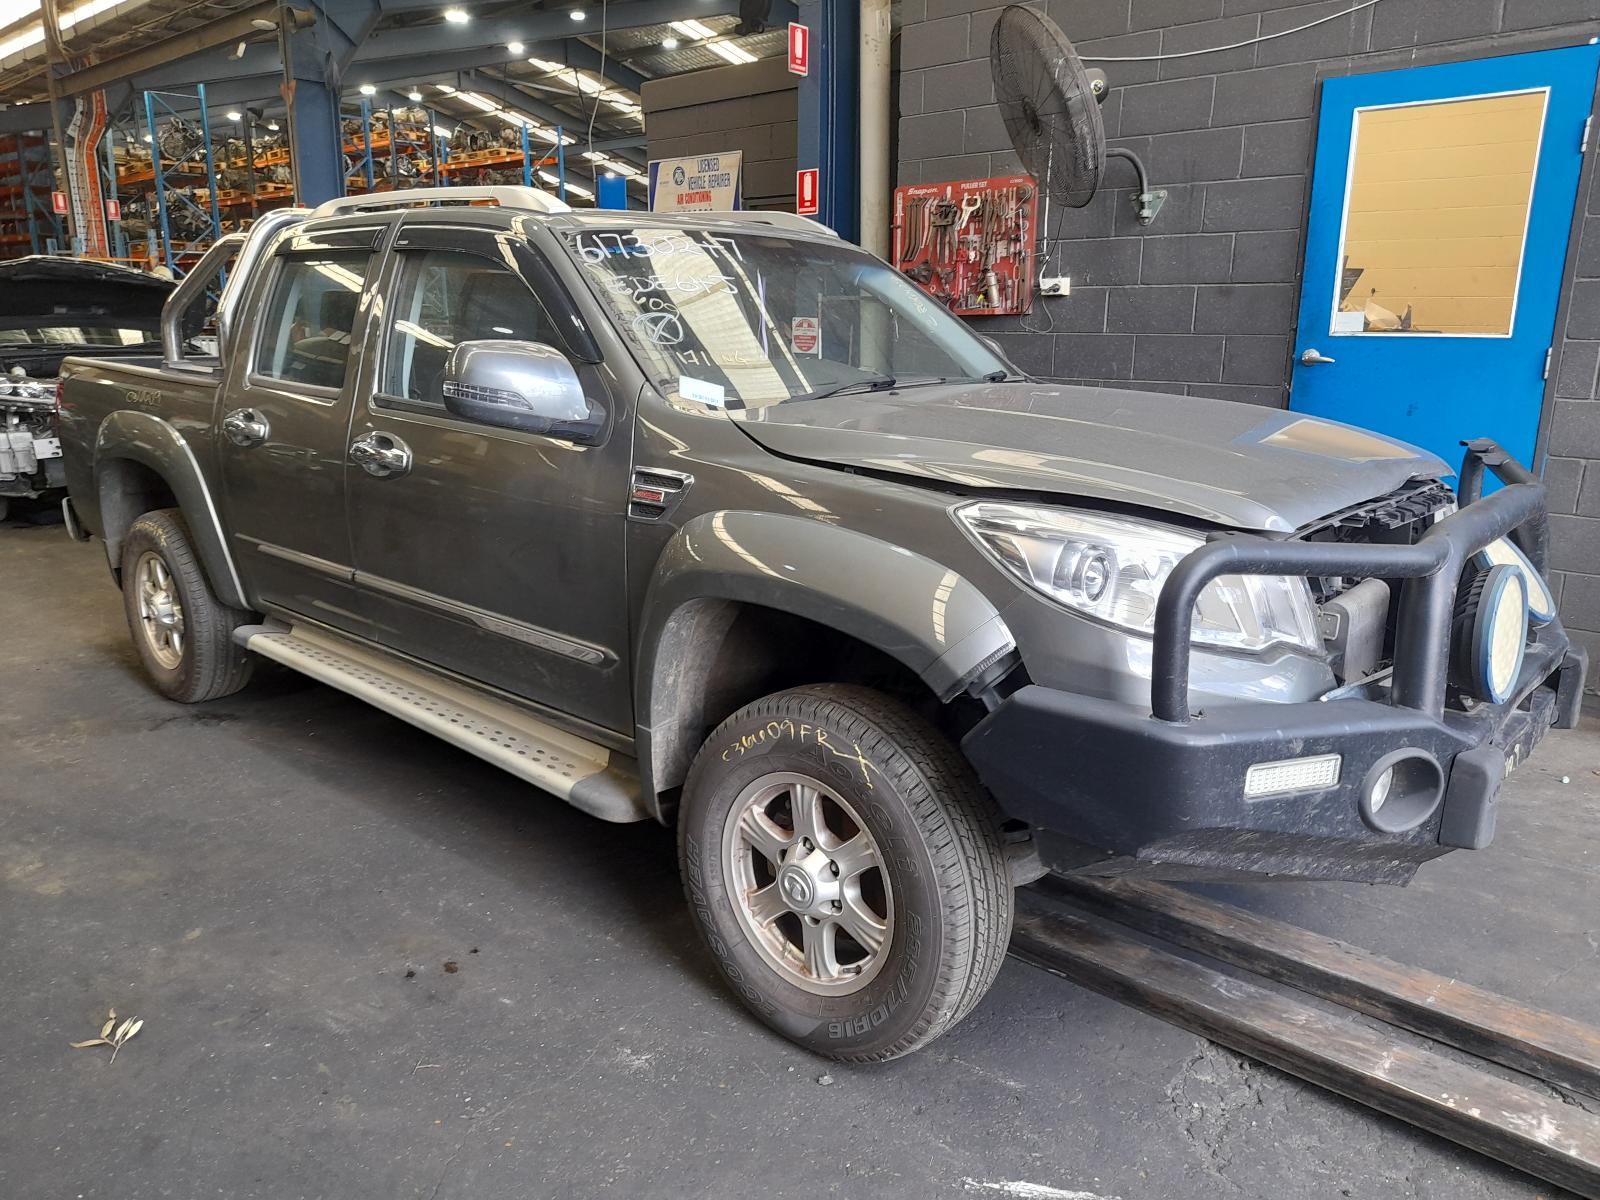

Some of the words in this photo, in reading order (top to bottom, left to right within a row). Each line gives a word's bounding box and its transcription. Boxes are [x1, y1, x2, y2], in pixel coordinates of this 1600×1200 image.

[697, 158, 720, 173] LICENSED
[688, 175, 706, 190] VEHICLE
[708, 173, 730, 189] REPAIRER
[684, 190, 712, 204] CONDITIONING
